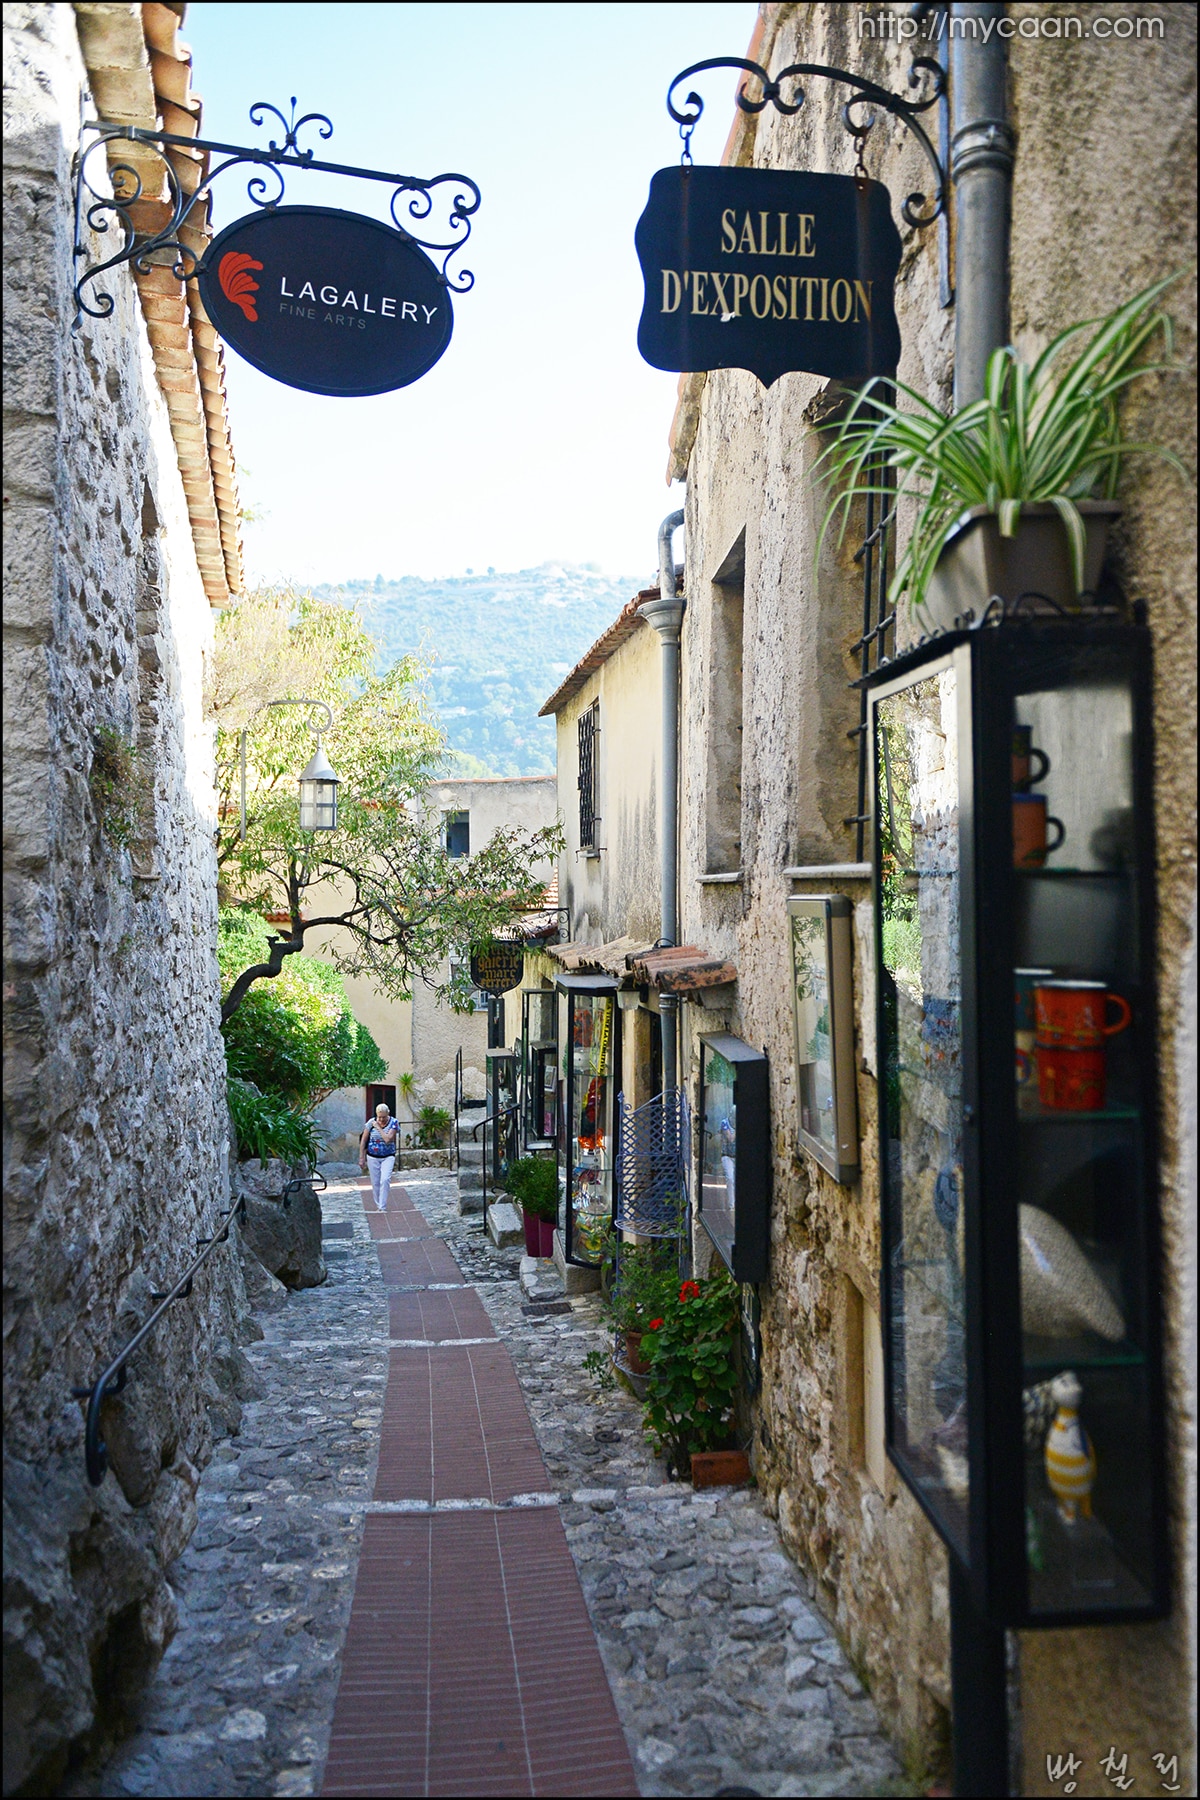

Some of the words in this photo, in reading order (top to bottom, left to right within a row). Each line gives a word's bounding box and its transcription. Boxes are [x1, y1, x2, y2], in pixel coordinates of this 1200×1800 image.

[720, 207, 817, 258] SALLE
[279, 276, 439, 325] LAGALERY
[659, 268, 875, 324] D'EXPOSITION
[279, 302, 317, 320] FINE
[323, 311, 367, 330] ARTS
[477, 956, 520, 973] galerie
[484, 968, 517, 979] marc
